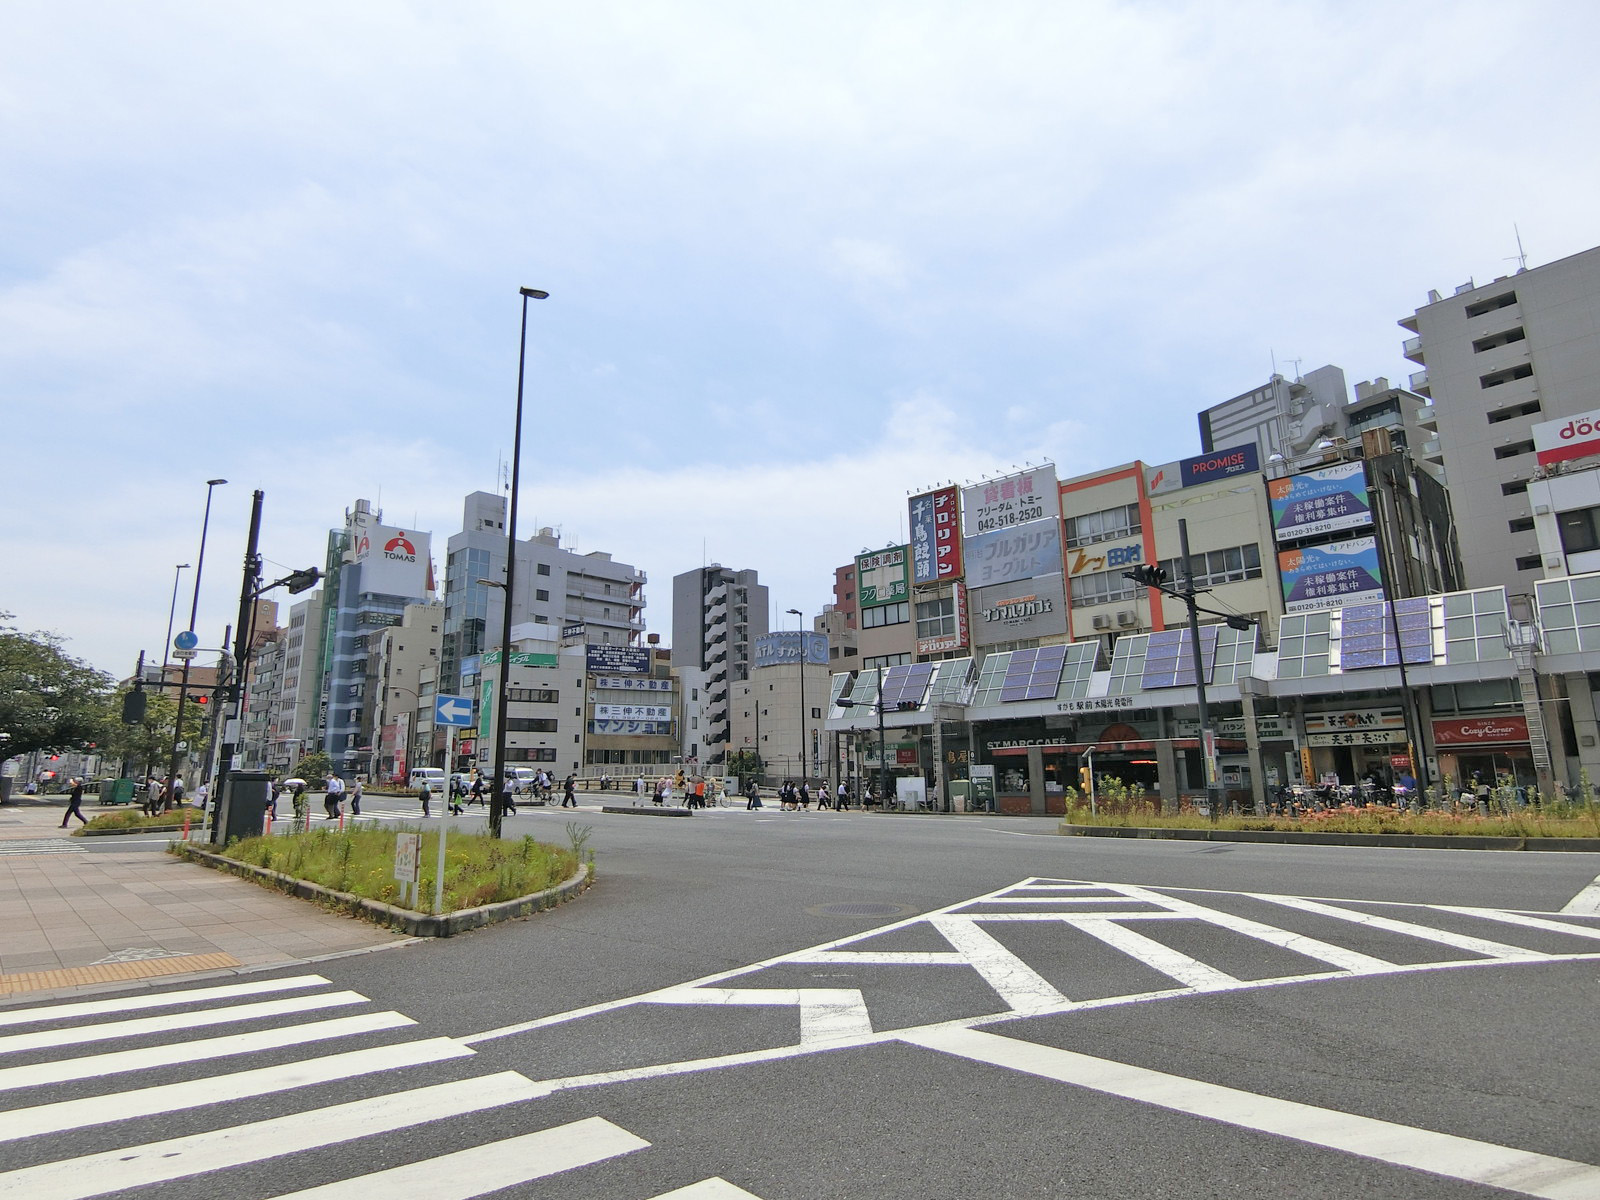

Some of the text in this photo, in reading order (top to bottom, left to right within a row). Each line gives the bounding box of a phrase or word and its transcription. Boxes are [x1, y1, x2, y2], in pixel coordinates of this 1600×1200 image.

[1192, 453, 1244, 475] PROMISE
[1224, 465, 1245, 474] プロミス
[1328, 463, 1362, 475] アドバンス
[983, 475, 1033, 505] 貸看板
[977, 496, 1043, 518] フリーダム・トミー
[1293, 494, 1346, 513] 未稼働案件
[978, 506, 1043, 531] 042-518-2520
[1295, 505, 1348, 523] 権利募集中
[912, 500, 931, 578] 千鳥饅頭
[934, 494, 953, 575] チロリアン
[1287, 524, 1332, 537] 0120-31-8210
[985, 529, 1057, 561] ブルガリア
[1339, 538, 1375, 550] アドバンス
[384, 551, 416, 563] TOMAS
[861, 551, 903, 570] 保険調剤
[982, 557, 1041, 581] ヨーグルト
[1303, 569, 1358, 587] 未稼働案件
[1304, 580, 1359, 597] 権利募集中
[981, 599, 1053, 623] サンマルクカフェ
[1297, 598, 1343, 611] 0120-31-8210
[755, 643, 775, 658] ホテル
[1460, 726, 1515, 738] Cozy Corner
[1002, 739, 1034, 749] MARC
[1036, 735, 1067, 747] CAFÉ
